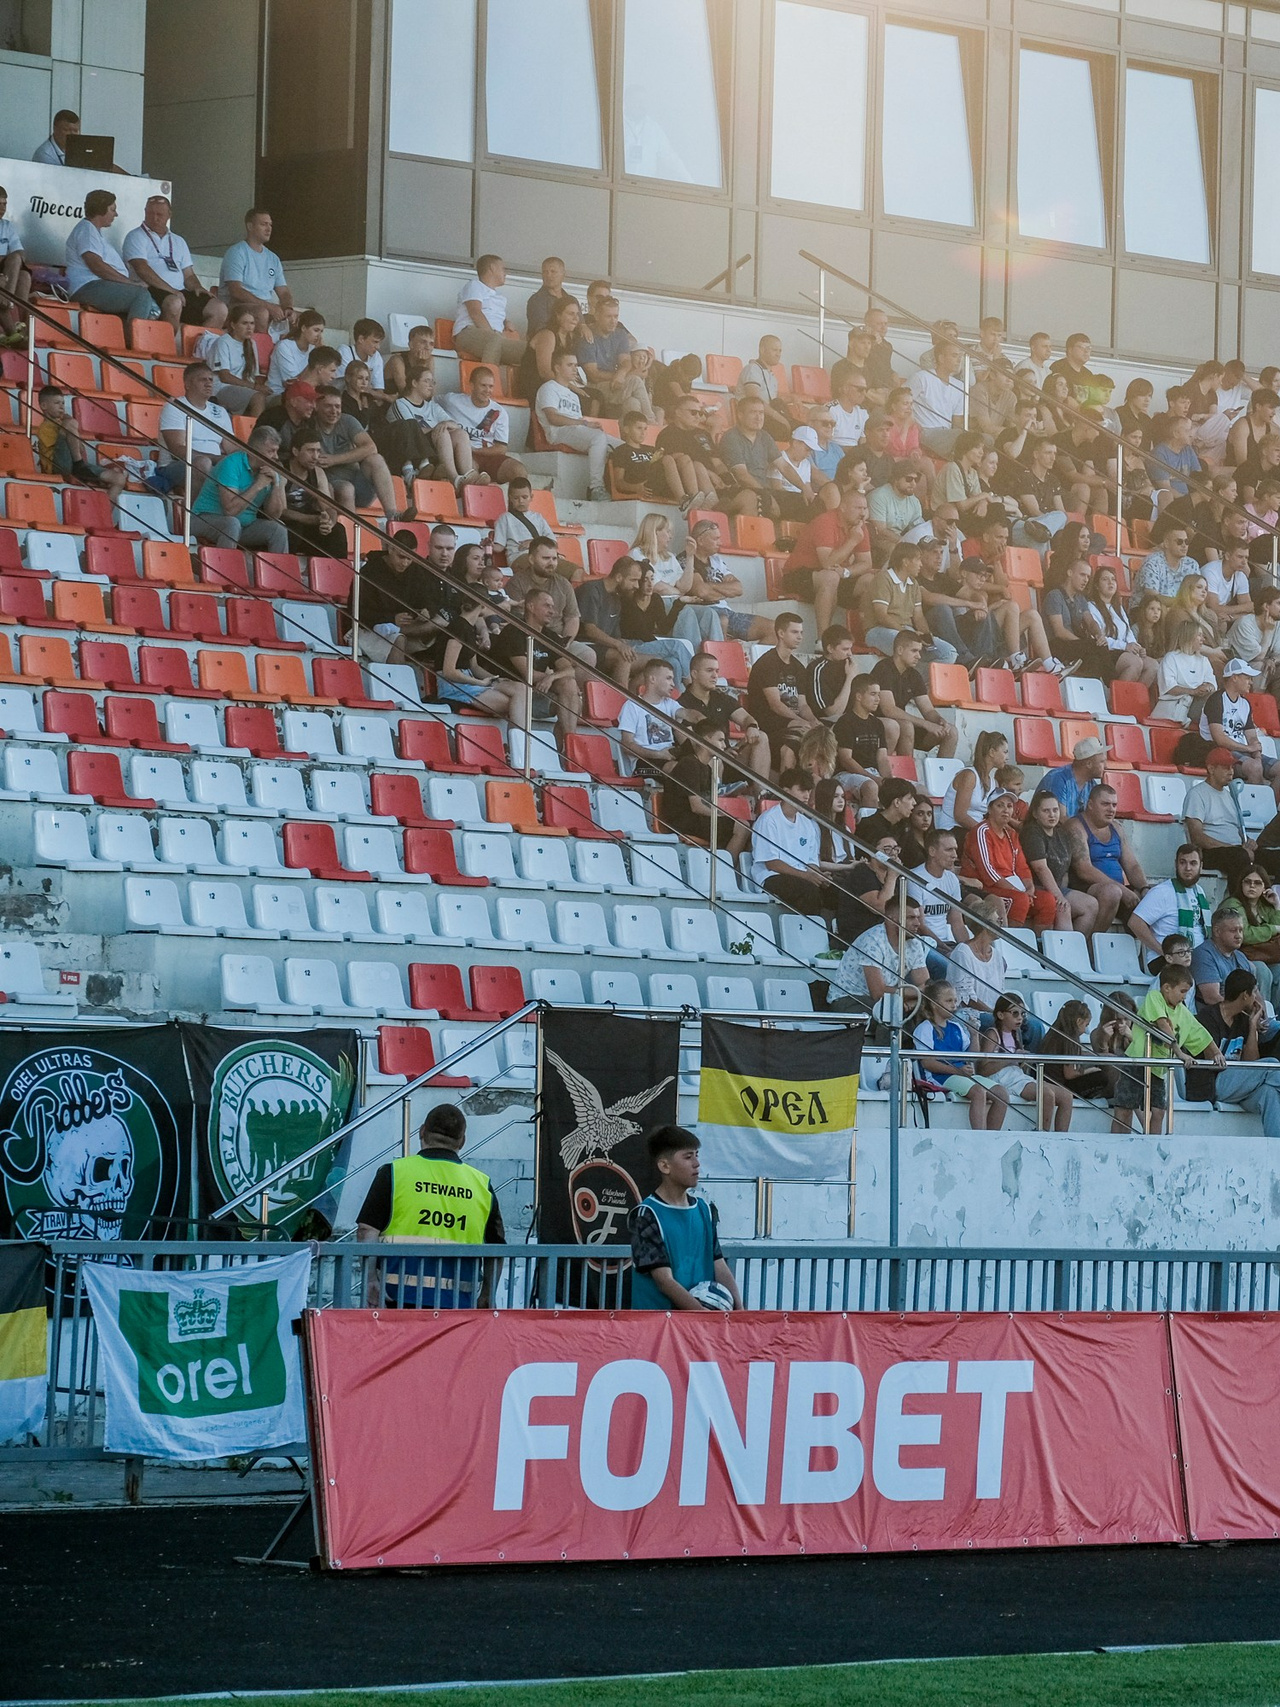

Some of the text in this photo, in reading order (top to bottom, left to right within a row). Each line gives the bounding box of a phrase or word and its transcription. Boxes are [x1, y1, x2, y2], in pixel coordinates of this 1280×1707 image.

[30, 195, 83, 219] Пресса
[10, 1053, 92, 1101] OREL ULTRAS
[222, 1054, 327, 1114] BUTCHERS
[414, 1181, 473, 1200] STEWARD
[45, 1213, 80, 1229] TRAVL
[417, 1208, 467, 1231] 2091
[156, 1343, 252, 1404] orel
[492, 1358, 1034, 1512] FONBET
